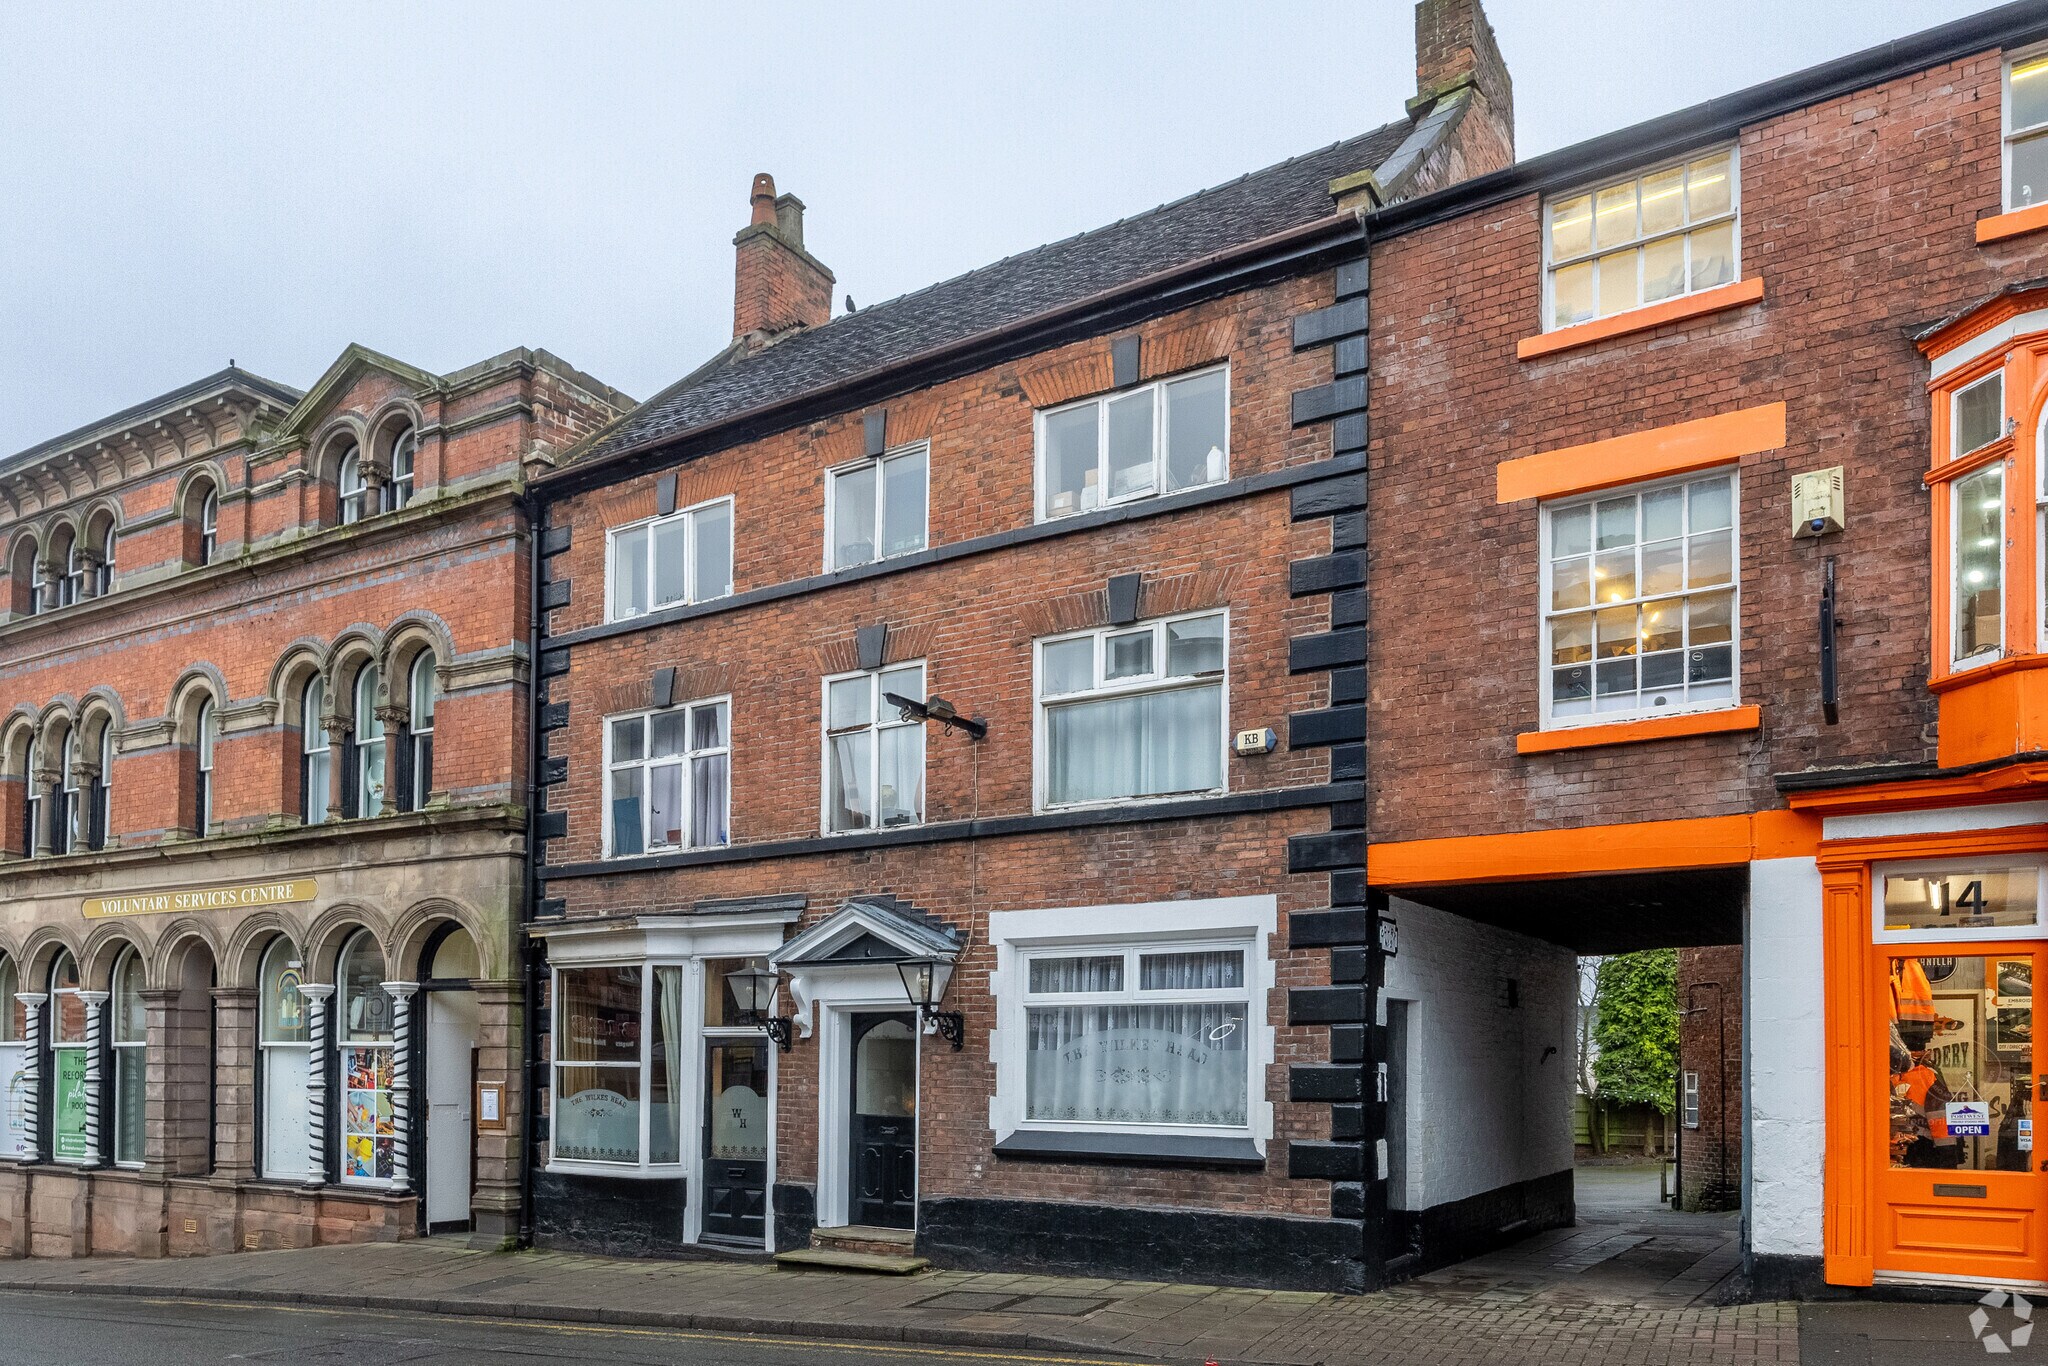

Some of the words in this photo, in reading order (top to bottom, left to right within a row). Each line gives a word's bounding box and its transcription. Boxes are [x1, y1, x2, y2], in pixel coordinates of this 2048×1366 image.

[1244, 733, 1259, 745] KB
[101, 895, 171, 914] VOLUNTARY
[174, 890, 237, 909] SERVICES
[241, 883, 294, 903] CENTRE
[1940, 880, 1988, 916] 14
[74, 1056, 87, 1066] THE
[66, 1080, 87, 1108] pilat
[570, 1097, 582, 1106] THE
[585, 1094, 609, 1102] WILKES
[610, 1096, 627, 1109] HEAD
[731, 1108, 743, 1118] W
[740, 1118, 747, 1128] H
[1954, 1125, 1982, 1134] OPEN
